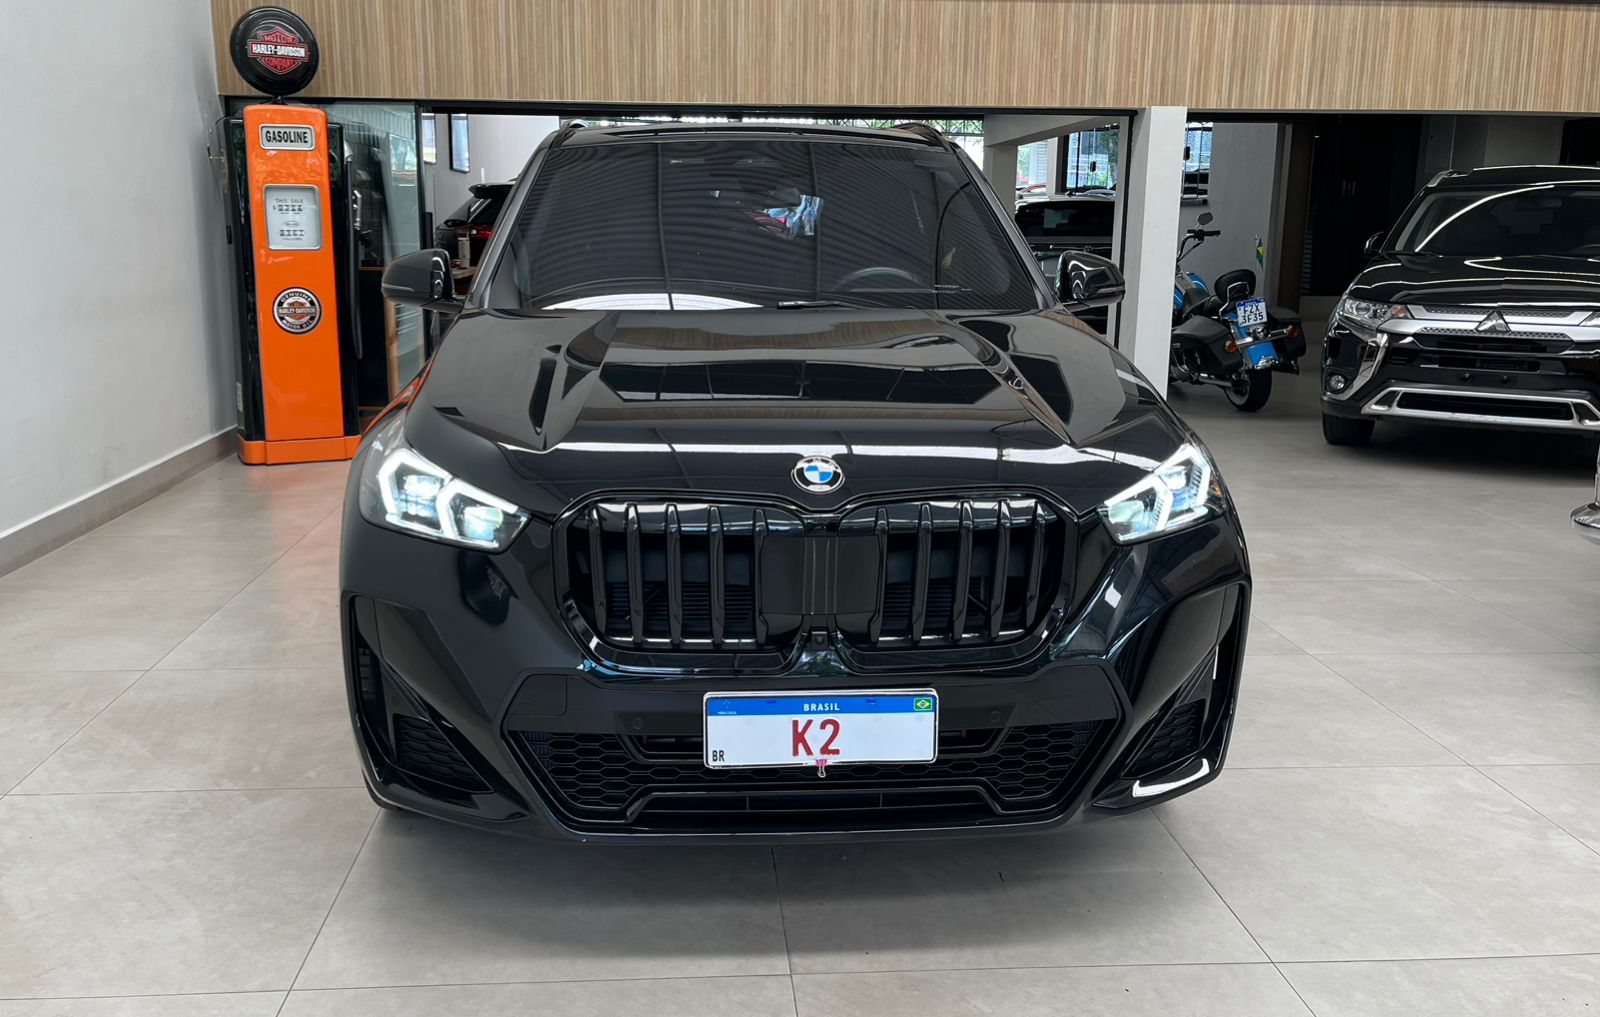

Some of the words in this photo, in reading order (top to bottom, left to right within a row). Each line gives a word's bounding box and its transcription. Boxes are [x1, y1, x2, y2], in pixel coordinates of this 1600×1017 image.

[252, 43, 306, 57] HARLEY-DAVIDSON
[265, 130, 308, 143] GASOLINE
[1243, 304, 1260, 315] FZX
[1241, 311, 1264, 324] 3F35
[803, 702, 840, 712] BRASIL
[792, 718, 840, 757] K2
[712, 750, 725, 762] BR
